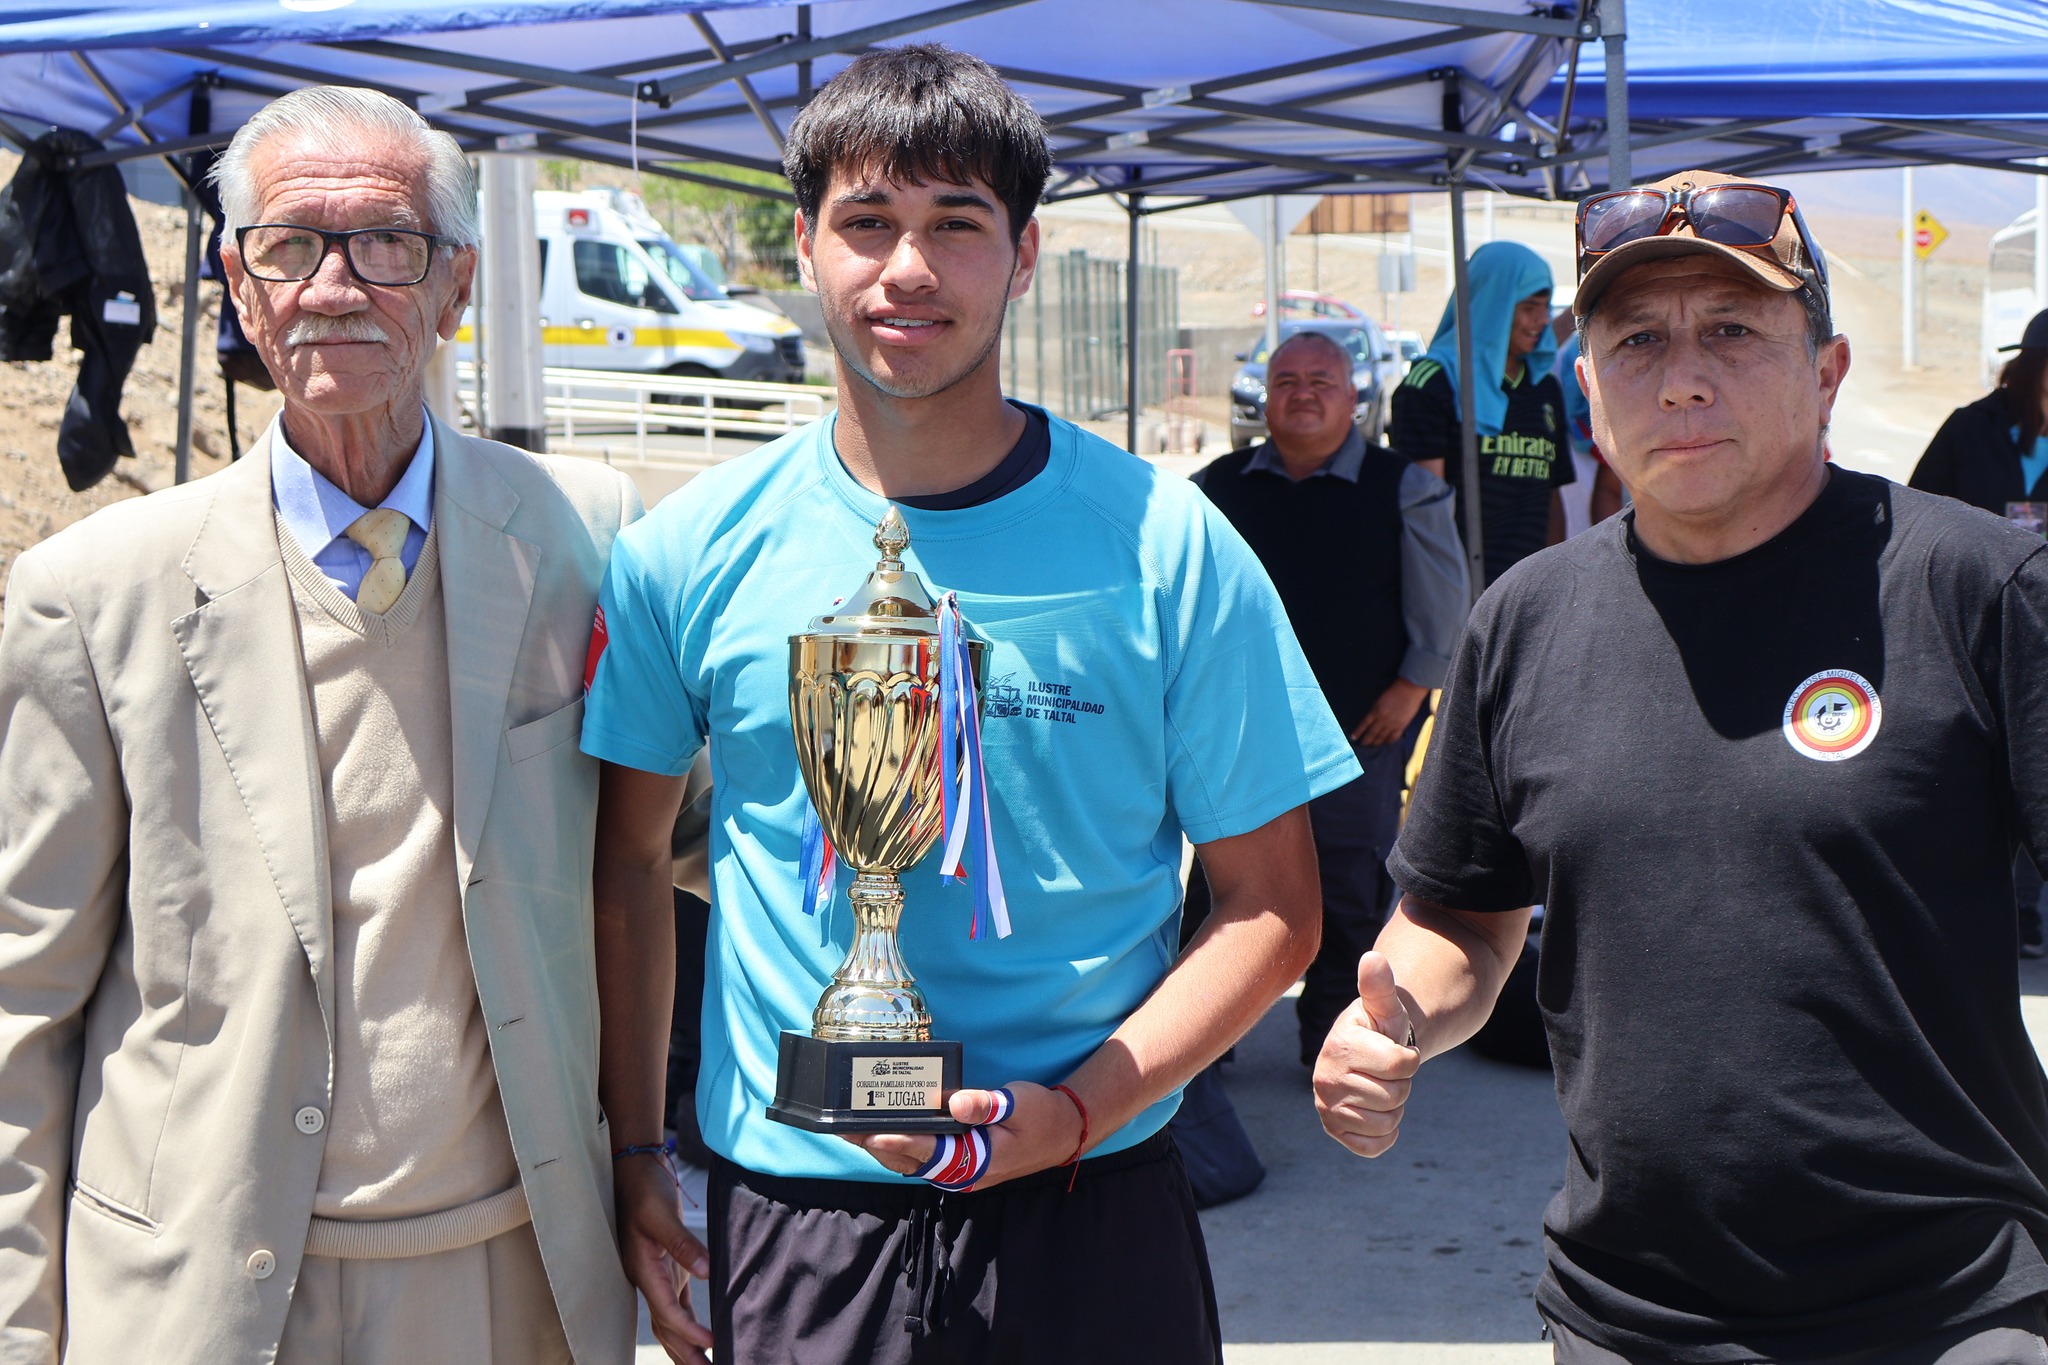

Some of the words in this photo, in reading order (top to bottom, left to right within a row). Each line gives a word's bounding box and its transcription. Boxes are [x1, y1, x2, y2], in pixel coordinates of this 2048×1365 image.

[1492, 455, 1511, 475] FY
[1028, 681, 1072, 696] ILUSTRE
[1785, 692, 1800, 718] LICEO
[1826, 670, 1860, 683] MIGUEL
[1026, 694, 1105, 715] MUNICIPALIDAD
[1025, 707, 1041, 719] DE
[1043, 709, 1077, 724] TALTAL
[1818, 751, 1847, 761] TALTAL
[856, 1080, 879, 1088] CORRIDA
[880, 1080, 905, 1088] FAMILIAR
[905, 1080, 925, 1088] PAPOSO
[888, 1091, 926, 1107] LUGAR
